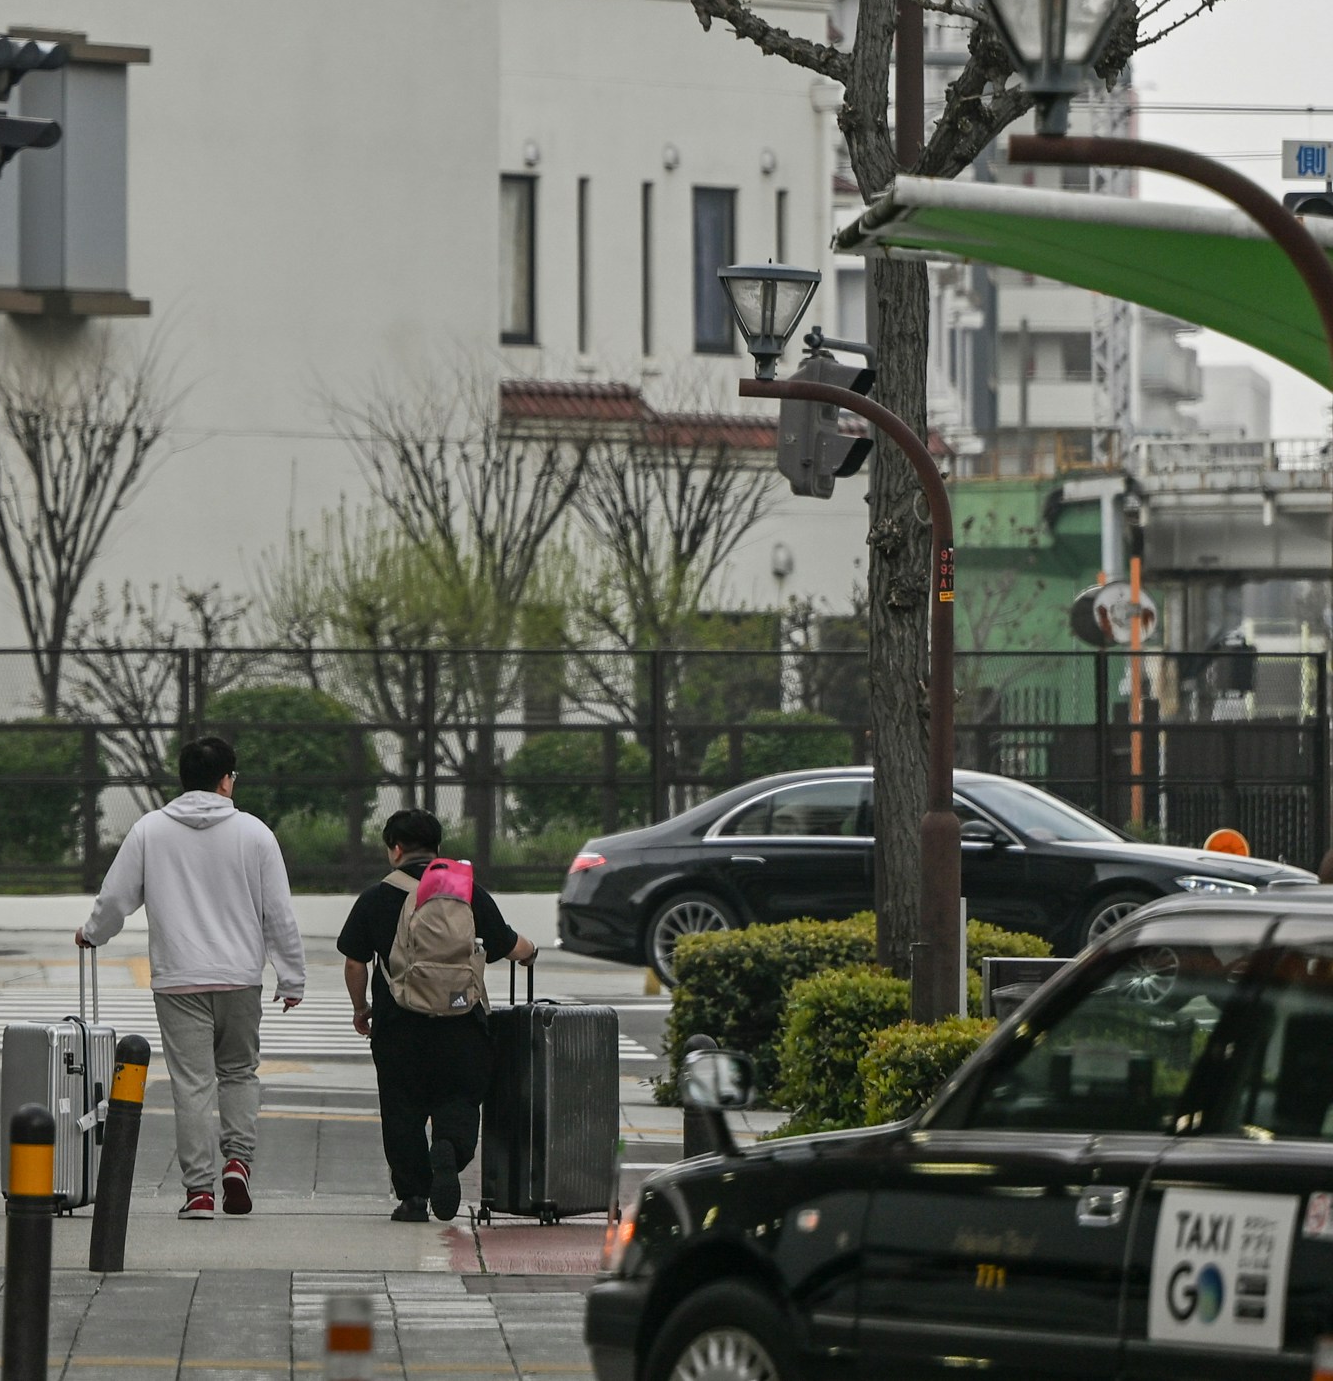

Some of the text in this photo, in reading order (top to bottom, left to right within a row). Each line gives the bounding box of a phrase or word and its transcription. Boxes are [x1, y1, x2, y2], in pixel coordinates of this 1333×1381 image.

[1297, 145, 1326, 177] 側
[1176, 1211, 1235, 1253] TAXI
[1166, 1259, 1225, 1323] GO
